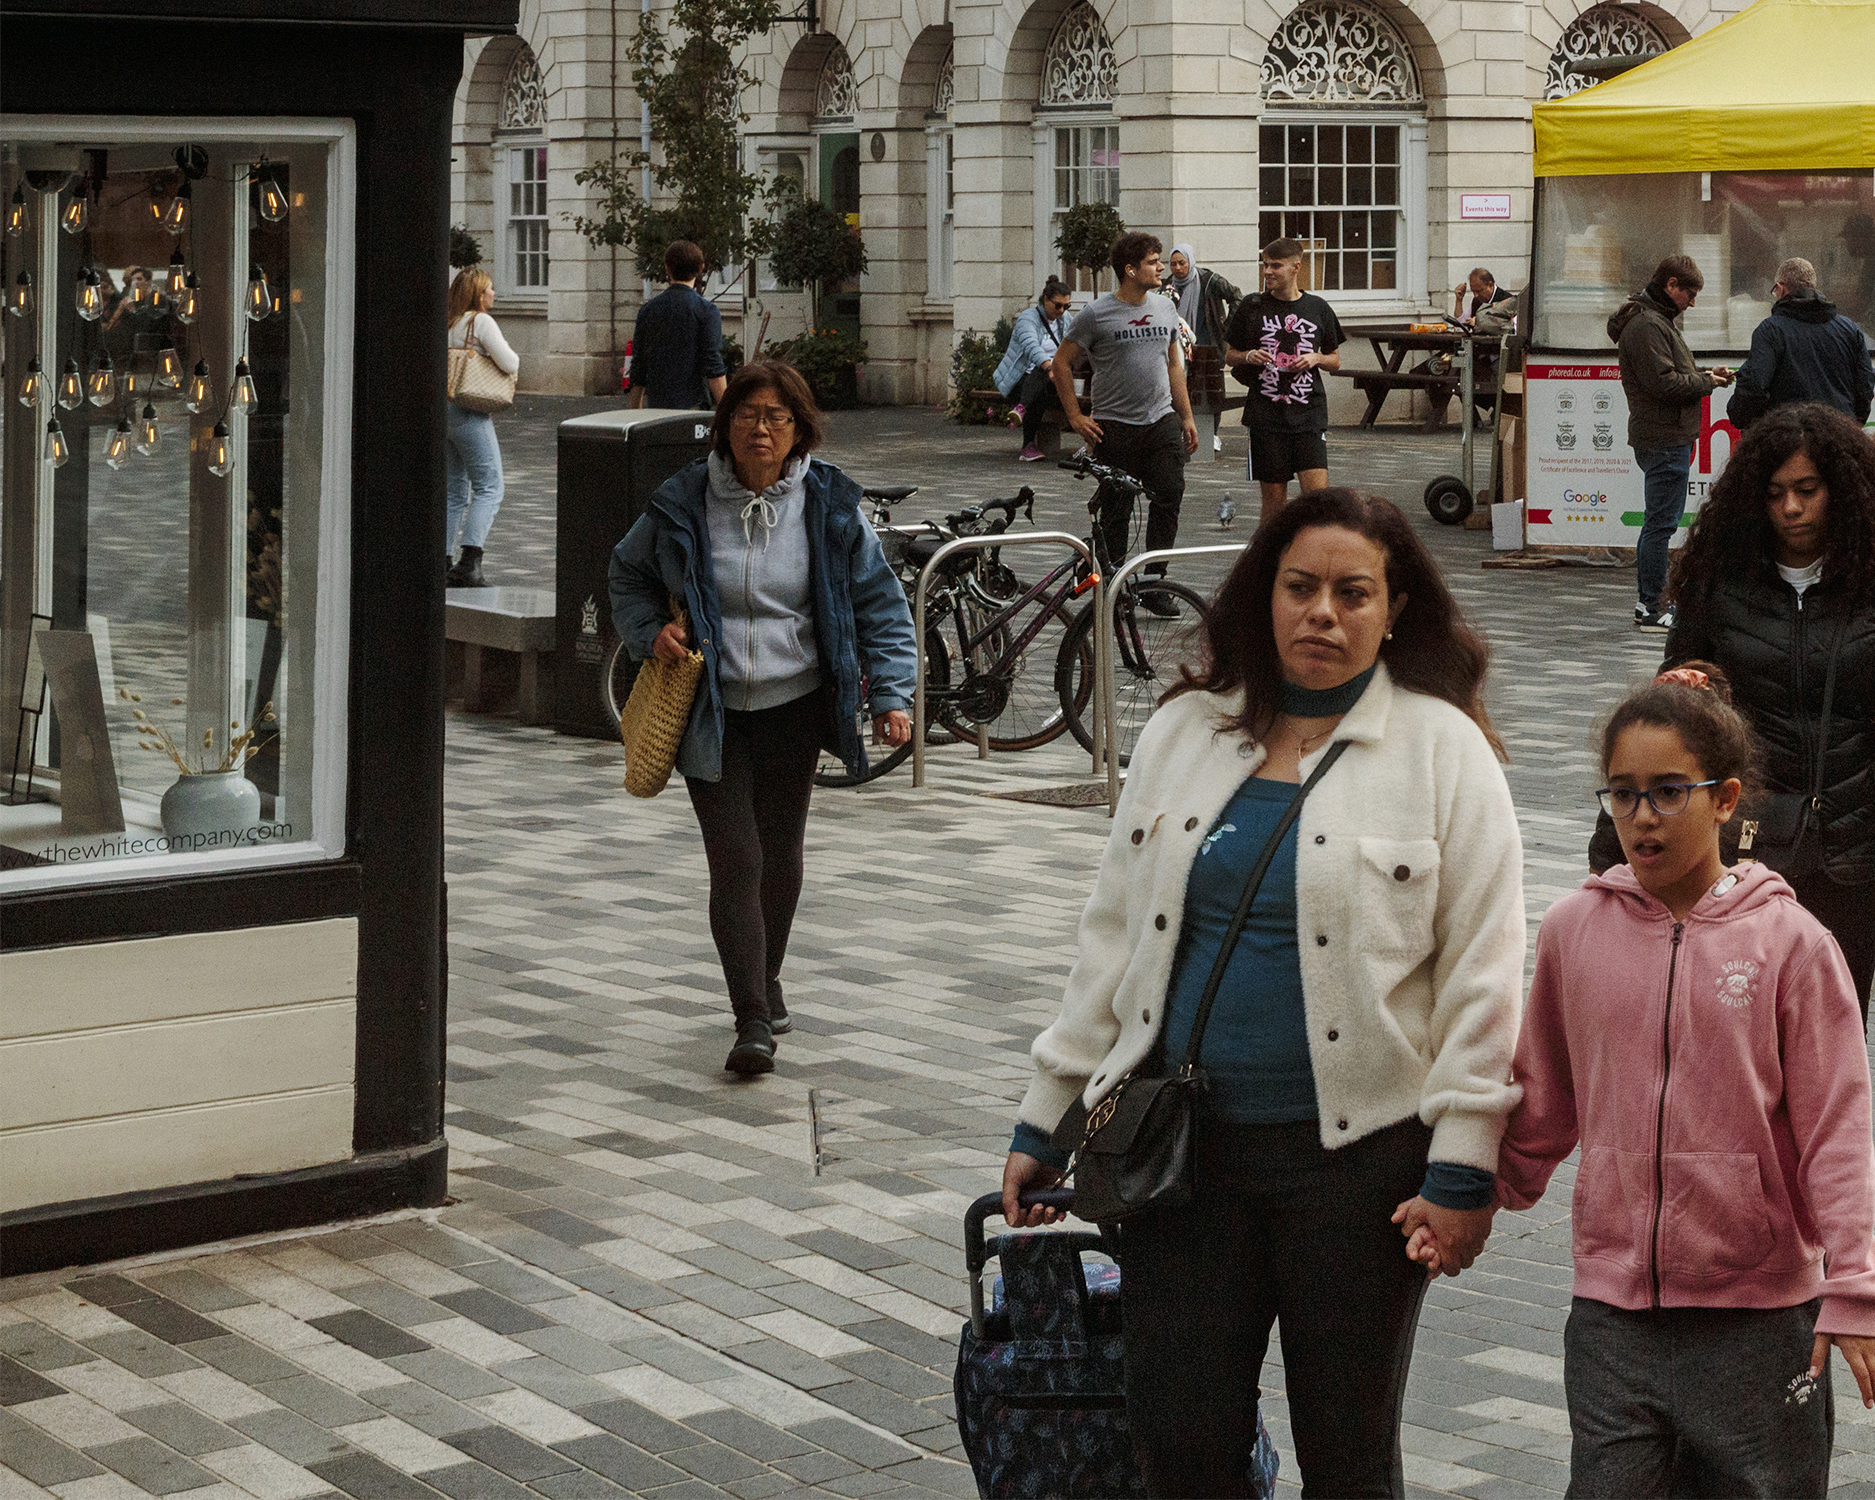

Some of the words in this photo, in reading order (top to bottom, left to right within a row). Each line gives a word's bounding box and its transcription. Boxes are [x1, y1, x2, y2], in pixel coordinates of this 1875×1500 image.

[1114, 326, 1169, 341] HOLLISTER
[1548, 367, 1592, 379] phoreal.co.uk
[1563, 489, 1607, 506] Google
[1717, 990, 1753, 1008] SOULCAL
